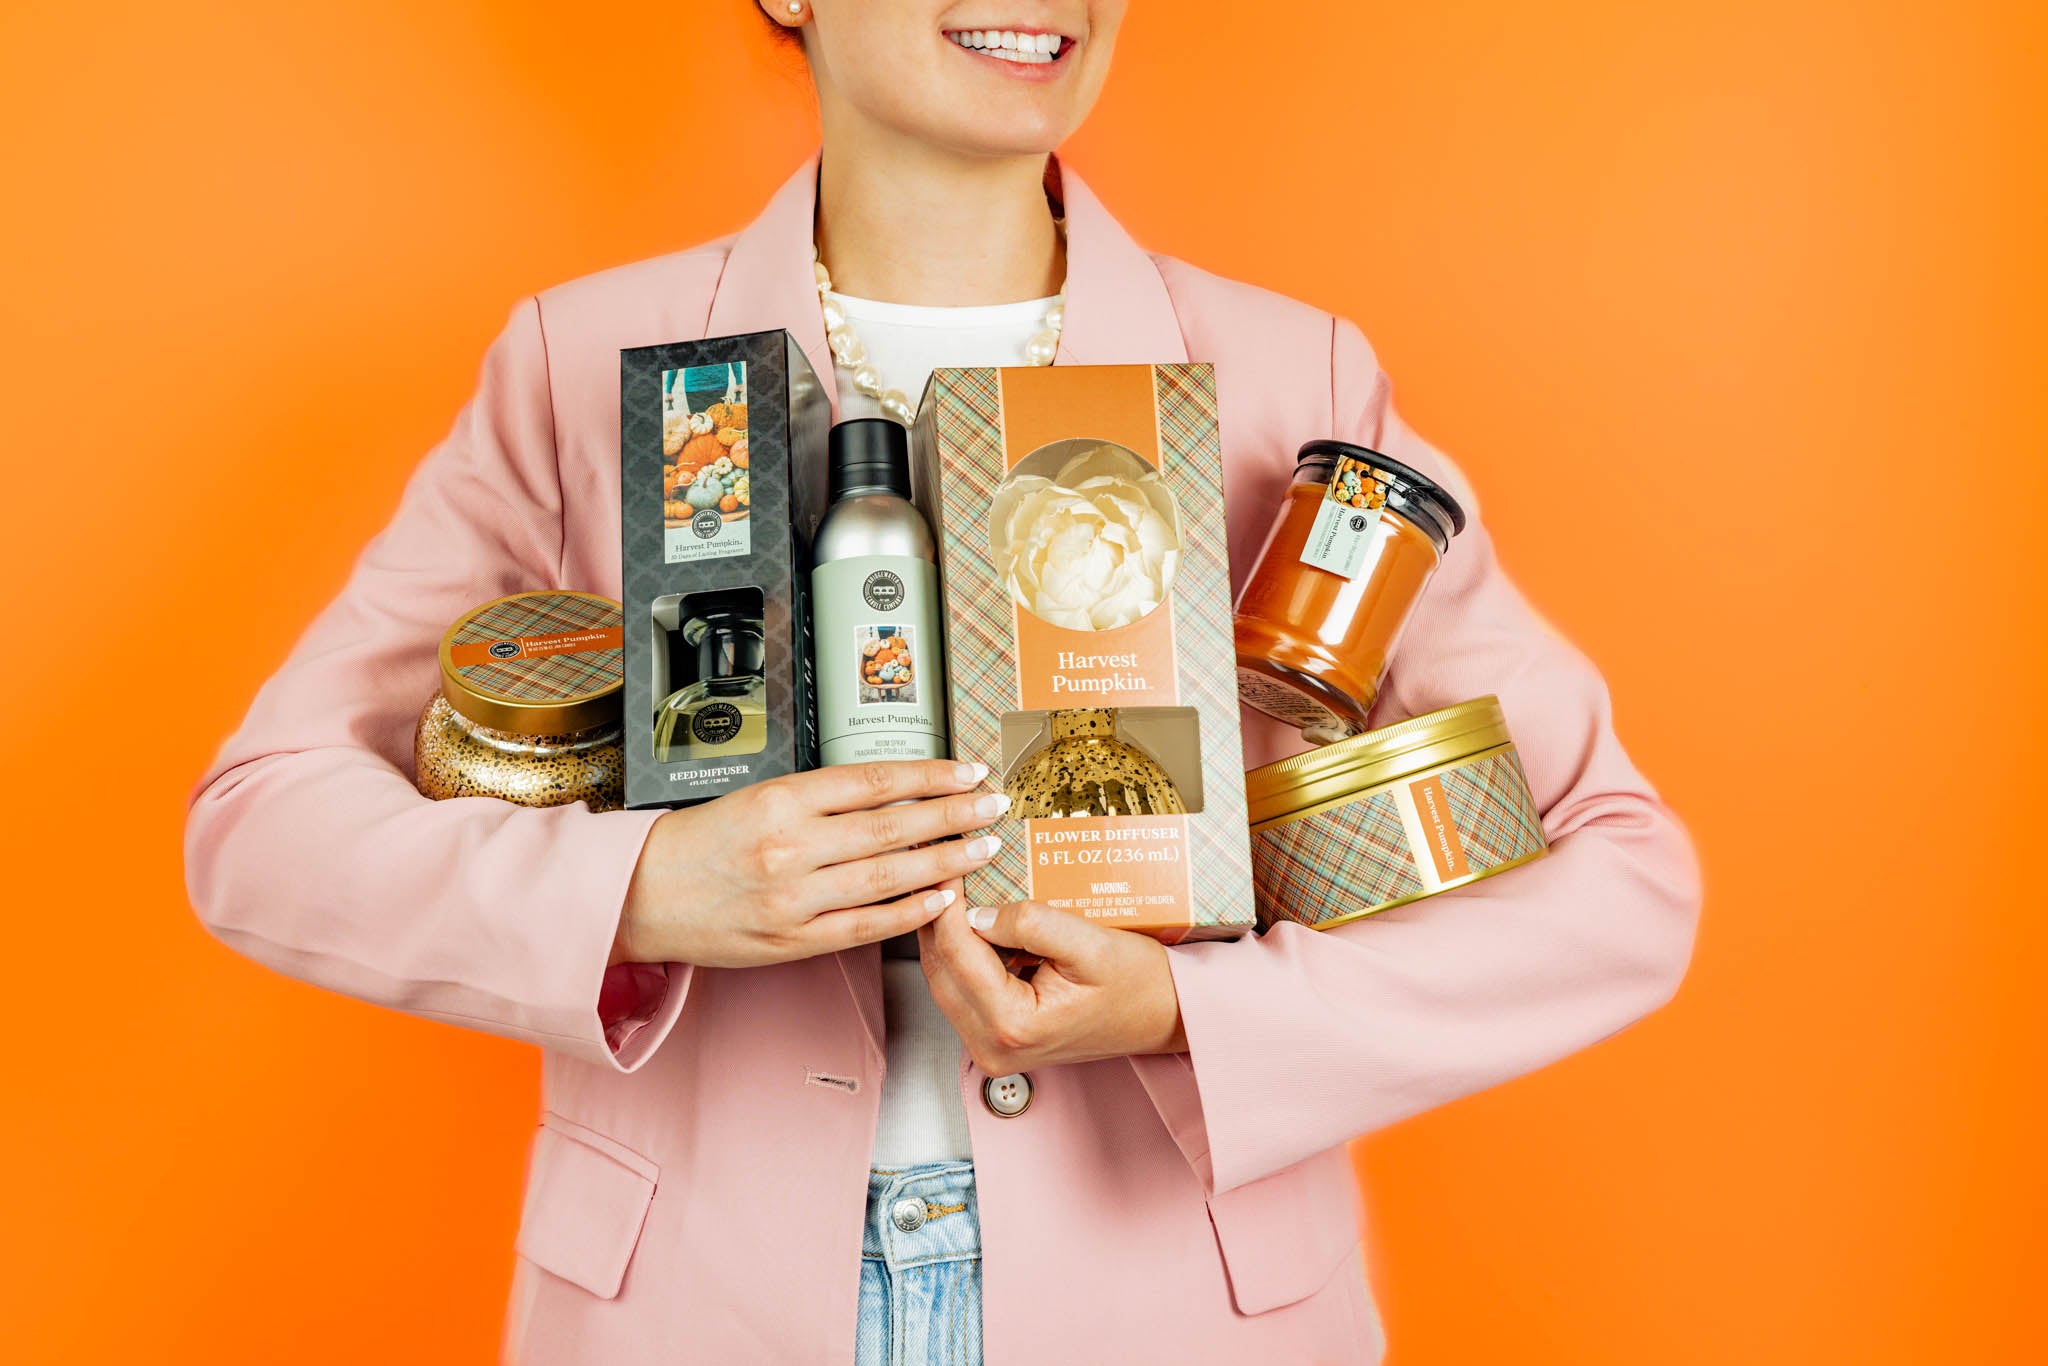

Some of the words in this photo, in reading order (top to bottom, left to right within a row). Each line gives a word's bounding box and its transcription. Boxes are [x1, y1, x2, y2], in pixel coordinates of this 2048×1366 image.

[1333, 507, 1346, 531] Harvest
[675, 543, 705, 552] Harvest
[526, 638, 561, 648] Harvest
[1057, 652, 1138, 669] Harvest
[848, 715, 885, 727] Harvest
[669, 770, 698, 782] REED
[699, 765, 750, 779] DIFFUSER
[1423, 786, 1441, 824] Harvest
[1035, 830, 1101, 844] FLOWER
[1105, 827, 1180, 841] DIFFUSER
[1038, 854, 1049, 866] 8
[1053, 852, 1075, 865] FL
[1077, 850, 1104, 865] OZ
[1106, 847, 1145, 864] (236
[1147, 846, 1180, 863] mL)
[1091, 882, 1131, 894] WARNING:
[1075, 898, 1090, 907] KEEP
[1092, 897, 1104, 907] OUT
[1105, 897, 1113, 906] OF
[1115, 896, 1135, 906] REACH
[1136, 896, 1144, 905] OF
[1102, 908, 1118, 917] BACK
